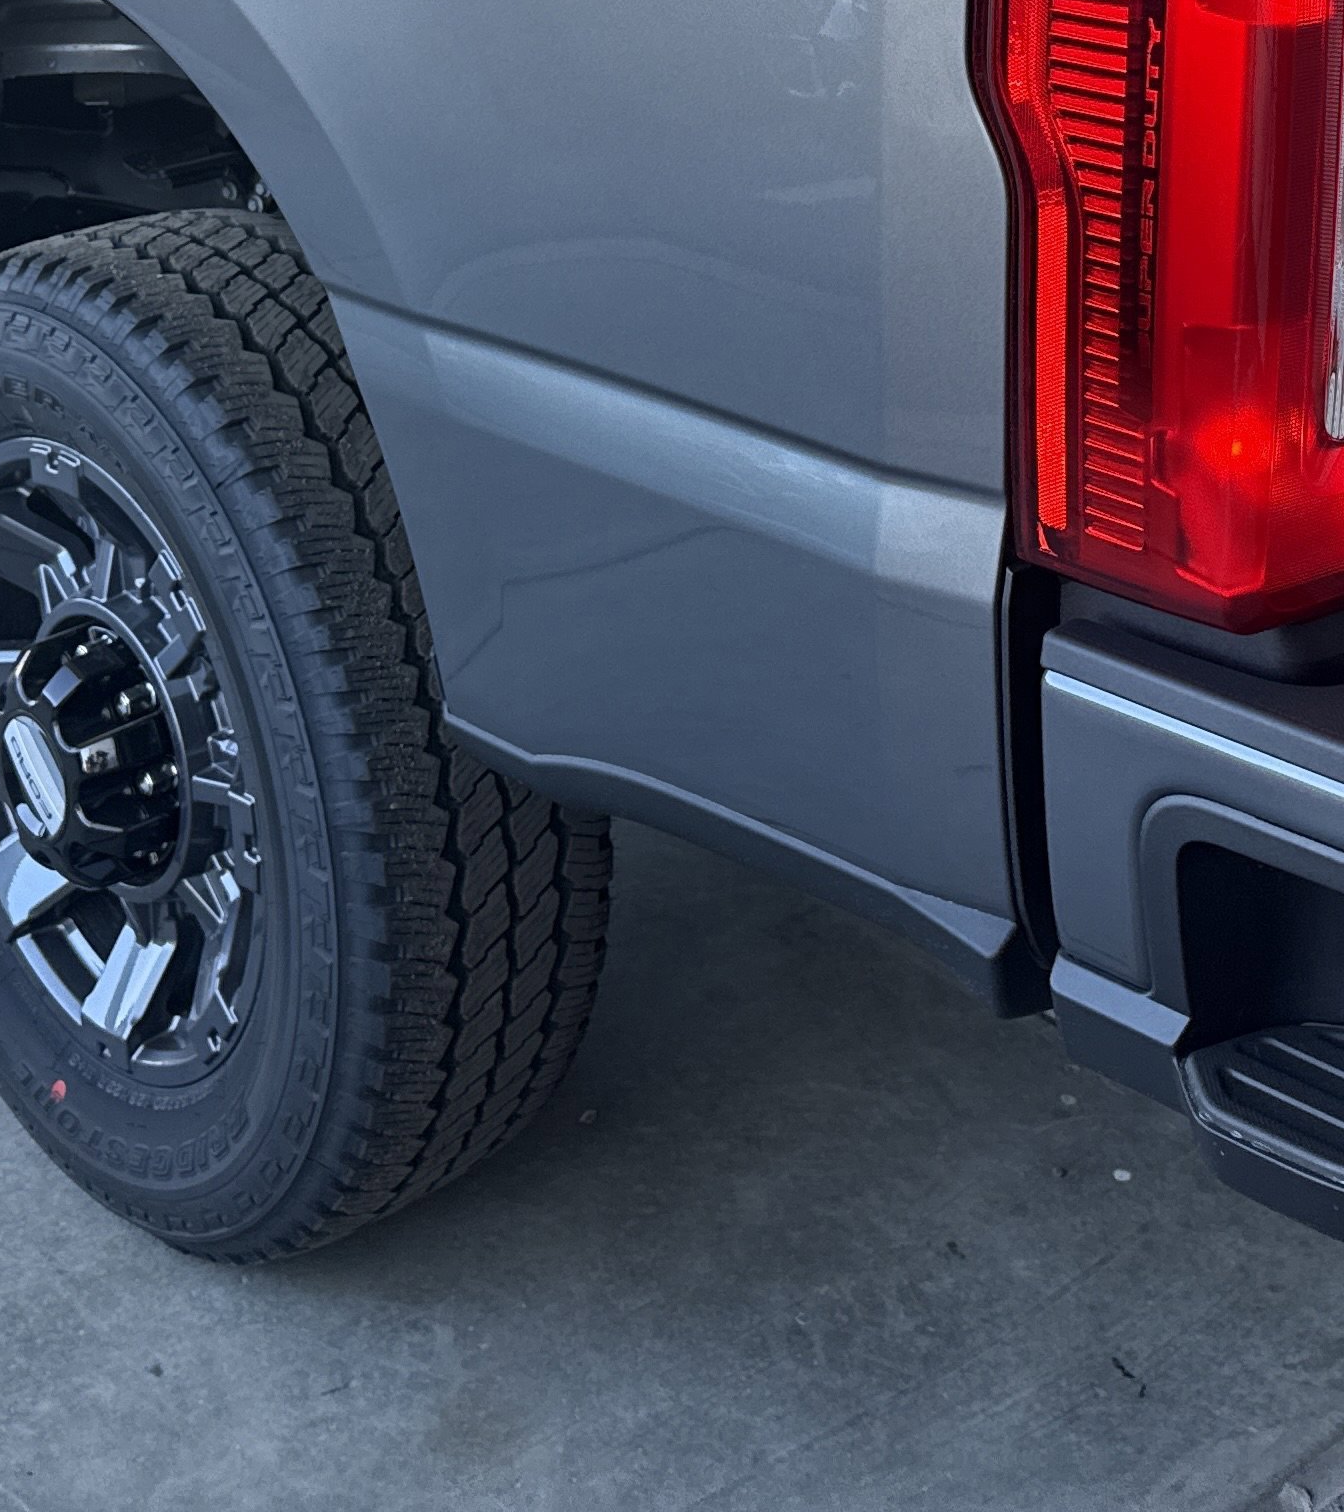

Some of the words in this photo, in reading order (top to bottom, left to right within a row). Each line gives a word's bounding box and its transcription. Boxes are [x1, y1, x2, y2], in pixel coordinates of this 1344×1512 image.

[1142, 16, 1161, 169] DUTY
[10, 735, 53, 820] FORD
[13, 1062, 252, 1183] BRIDGESTONE
